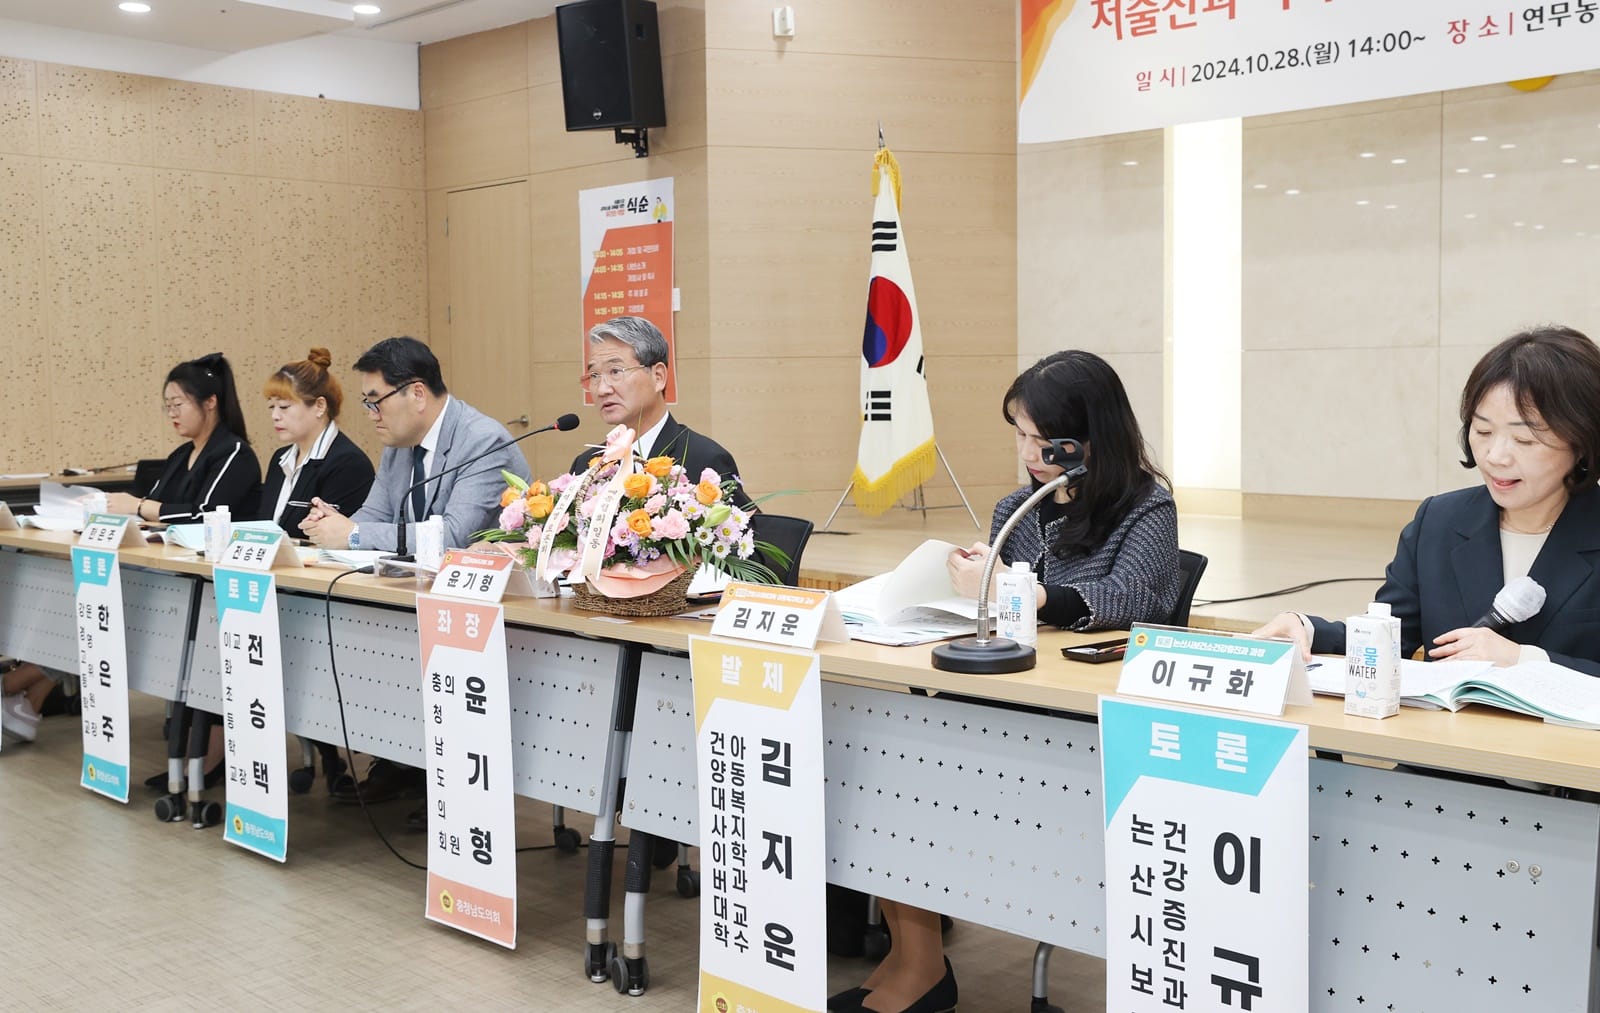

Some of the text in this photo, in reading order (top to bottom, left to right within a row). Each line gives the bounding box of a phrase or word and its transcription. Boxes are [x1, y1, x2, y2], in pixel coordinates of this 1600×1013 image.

[1522, 0, 1599, 32] 연무농
[1191, 41, 1340, 83] 2024.10.28.(월)
[1348, 30, 1426, 58] 14:00~
[627, 195, 649, 214] 식순
[447, 570, 494, 593] 윤기형
[437, 609, 481, 639] 좌장
[733, 607, 800, 637] 김지운
[999, 612, 1021, 622] WATER
[98, 604, 115, 743] 한은주
[721, 654, 785, 694] 발제
[1151, 659, 1255, 698] 이규화
[1348, 663, 1377, 680] WATER
[247, 634, 270, 795] 전승택
[432, 671, 447, 851] 충청남도의회
[465, 676, 493, 866] 윤기형
[1149, 721, 1249, 774] 토론
[709, 730, 730, 949] 건양대사이버대학
[730, 733, 750, 954] 아동복지학과 교수
[760, 736, 797, 973] 김지운
[456, 899, 502, 925] 충청남도의회
[1130, 813, 1156, 1013] 논산시보
[1162, 819, 1189, 1011] 건강증진과
[1210, 830, 1263, 1012] 이규
